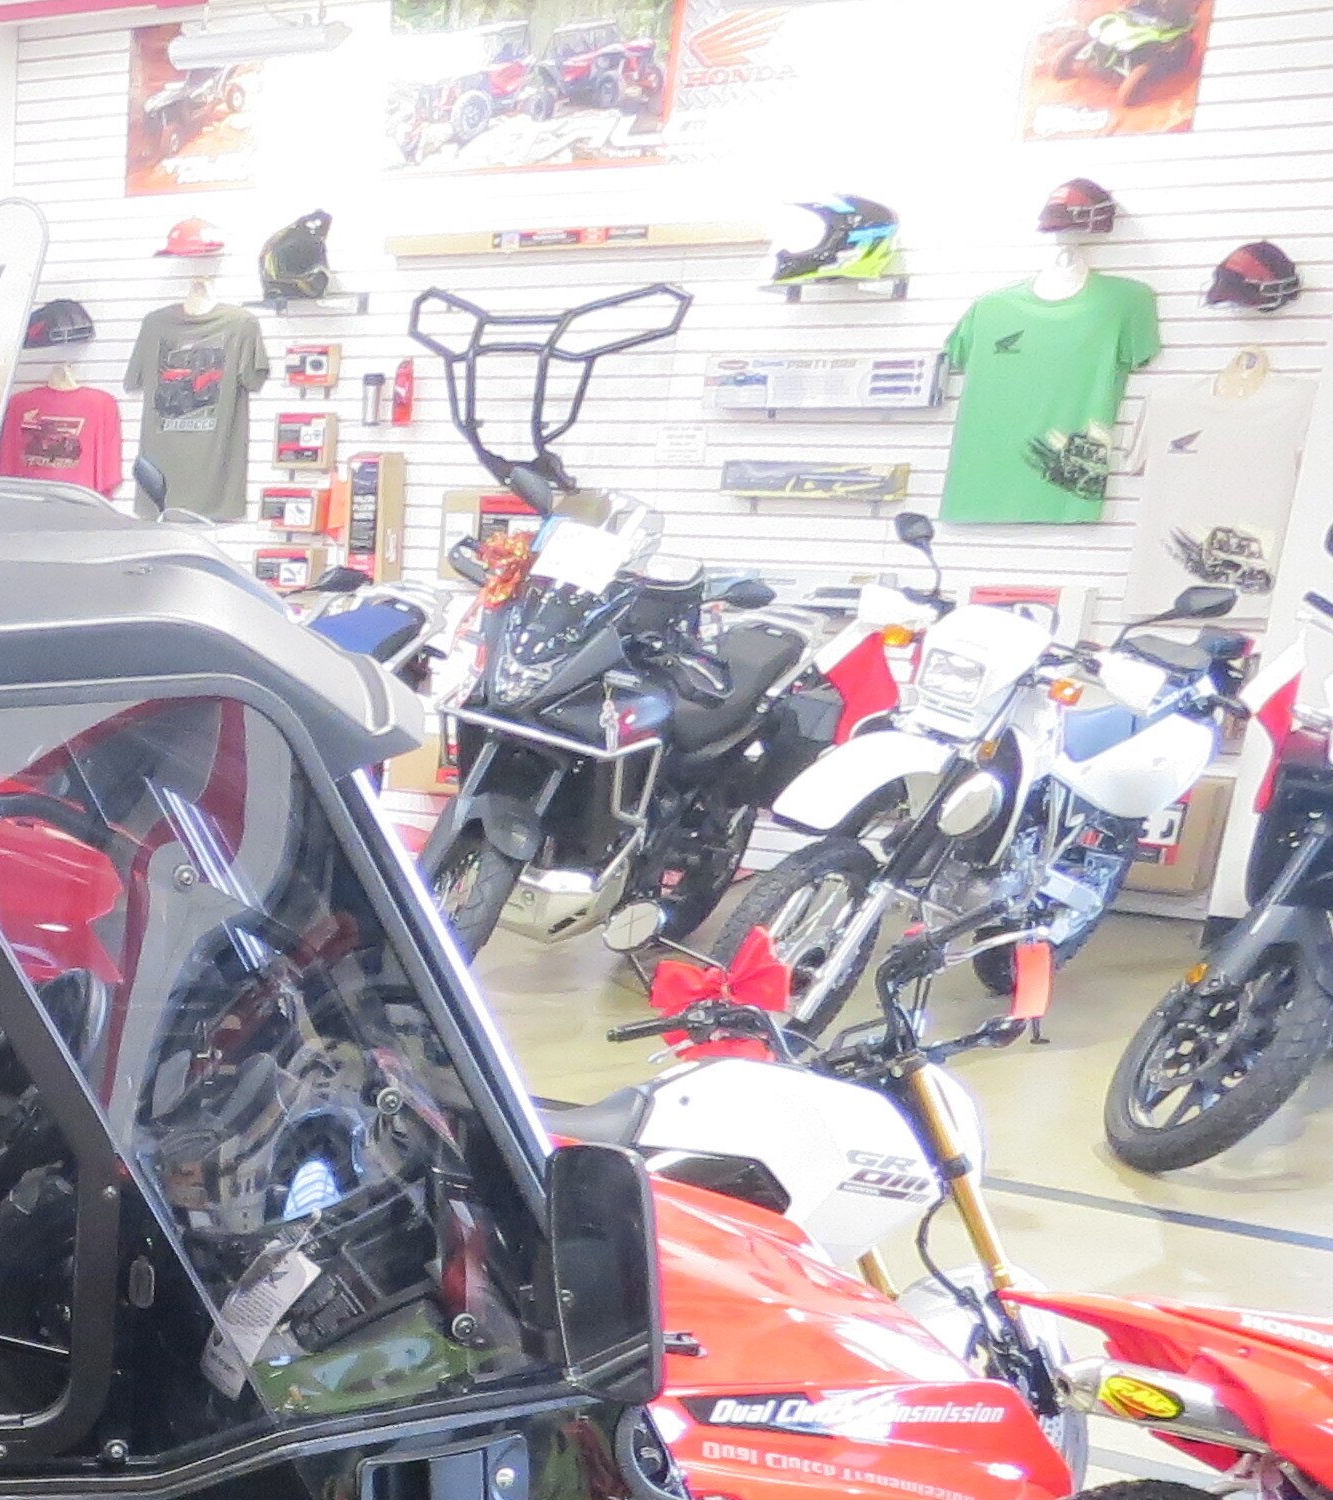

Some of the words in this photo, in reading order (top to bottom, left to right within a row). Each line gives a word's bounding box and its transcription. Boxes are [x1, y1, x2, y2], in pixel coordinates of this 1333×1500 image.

[684, 65, 799, 88] HONDA
[846, 1149, 918, 1173] GR
[709, 1399, 775, 1423] Dual
